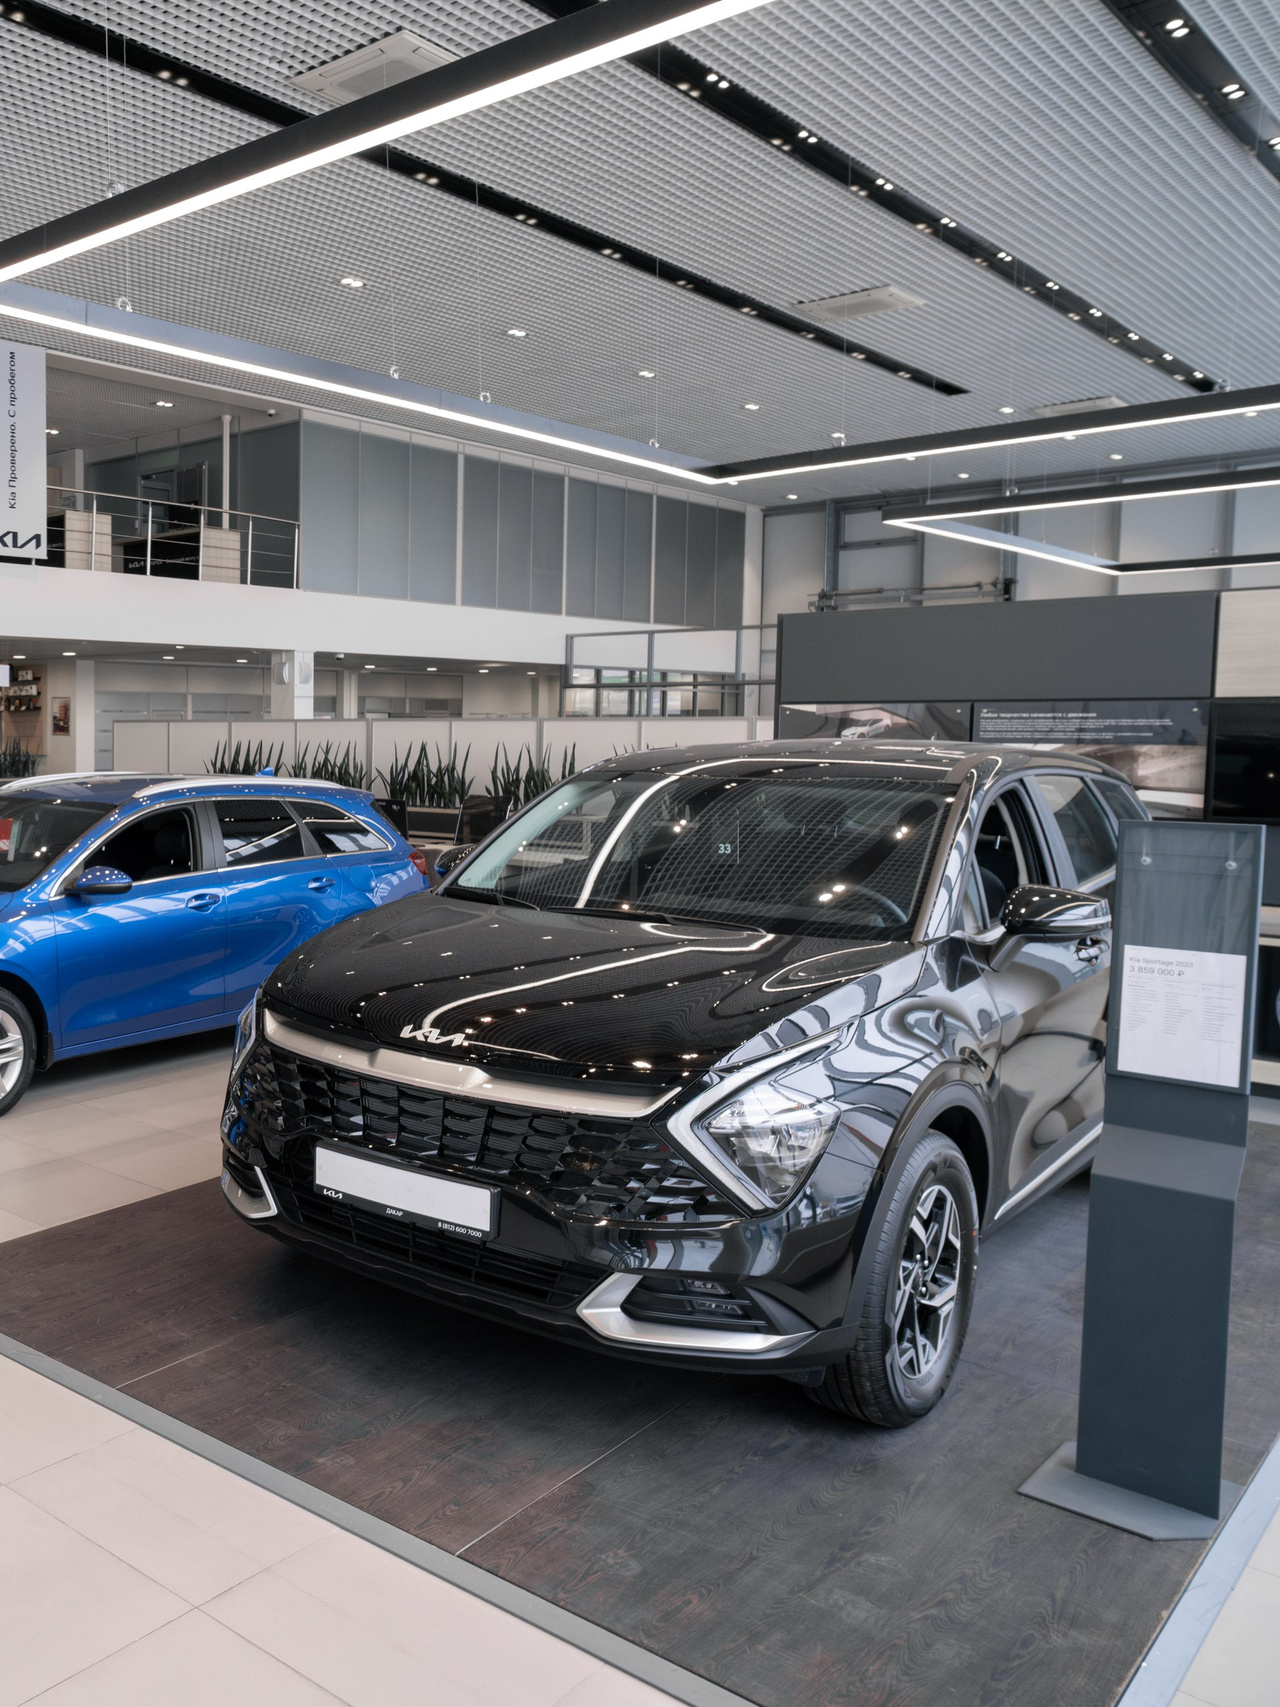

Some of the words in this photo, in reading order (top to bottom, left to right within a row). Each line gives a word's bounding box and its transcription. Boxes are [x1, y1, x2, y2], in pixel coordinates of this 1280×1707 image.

[8, 351, 18, 407] пробегом
[8, 409, 16, 418] С
[8, 422, 18, 488] Проверено.
[8, 490, 17, 509] Kia
[718, 843, 731, 854] 33
[1142, 957, 1174, 967] Sportage
[1175, 960, 1193, 968] 2023
[1129, 965, 1135, 973] 3
[1137, 966, 1155, 975] 859
[1157, 967, 1175, 977] 000
[399, 1023, 466, 1047] KIA
[323, 1188, 343, 1200] KIA
[385, 1207, 404, 1217] ДАКАР
[442, 1223, 456, 1231] (812)
[456, 1226, 467, 1234] 600
[467, 1228, 482, 1238] 7000
